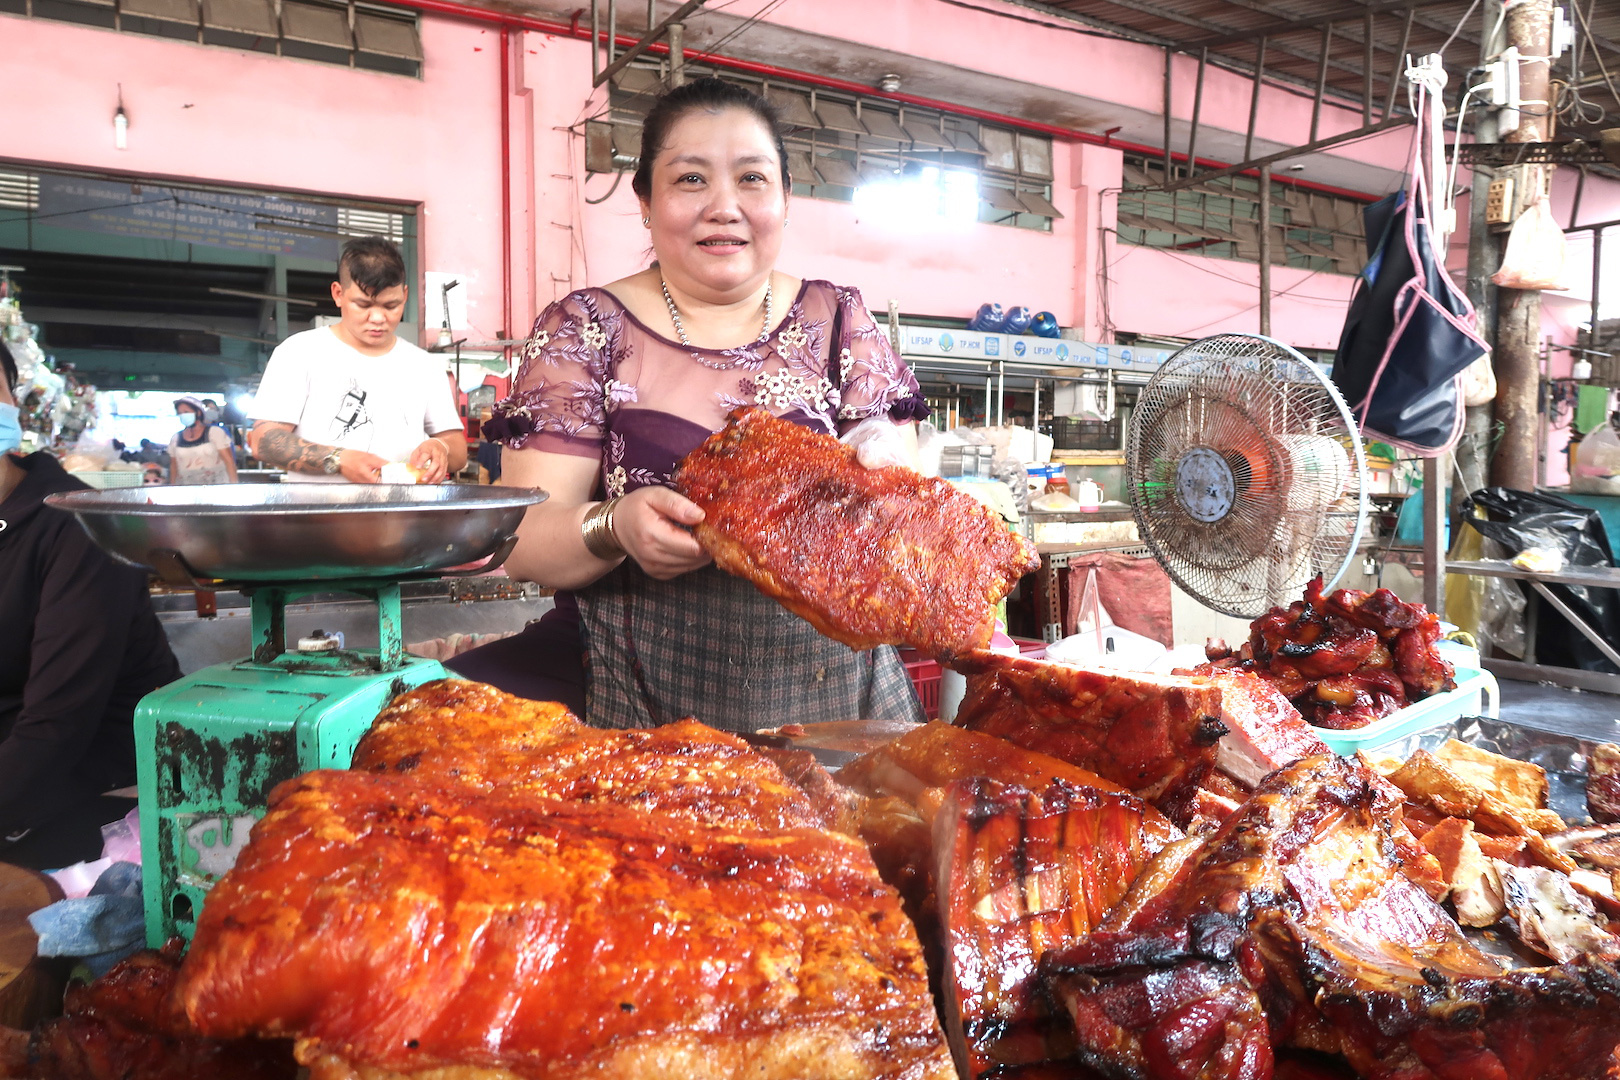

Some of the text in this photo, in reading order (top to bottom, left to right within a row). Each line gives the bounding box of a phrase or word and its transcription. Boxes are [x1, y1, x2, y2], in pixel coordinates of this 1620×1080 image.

[911, 336, 981, 350] LIFSAP TP.HCM
[1033, 346, 1053, 355] LIFSAP
